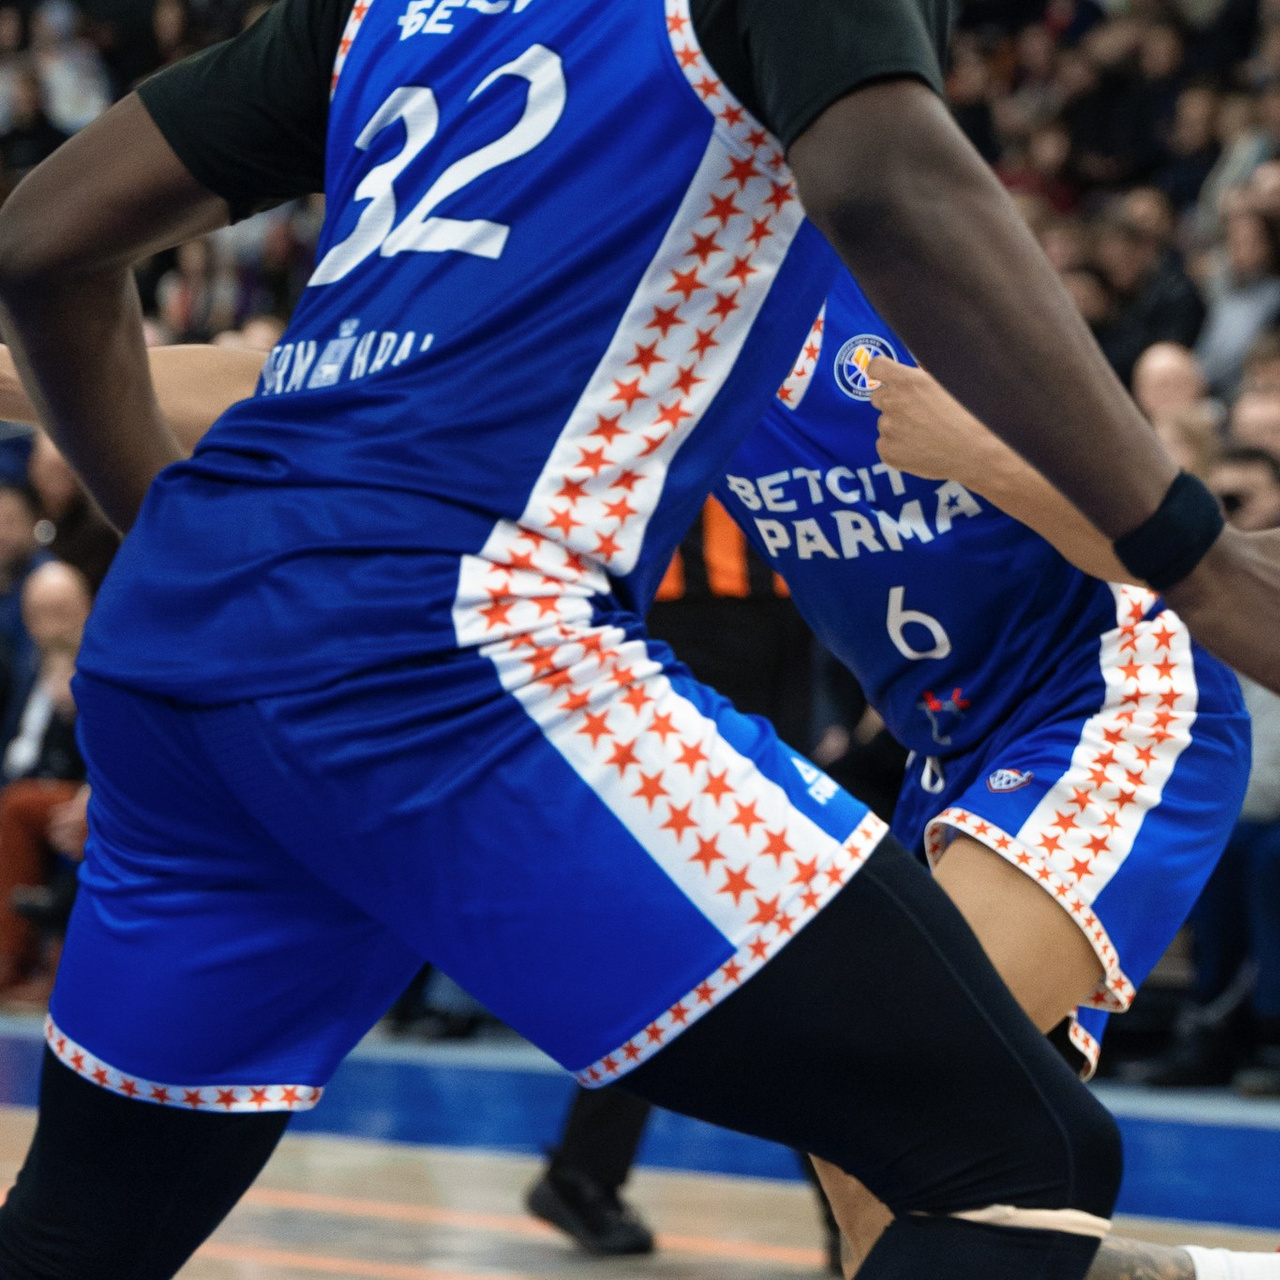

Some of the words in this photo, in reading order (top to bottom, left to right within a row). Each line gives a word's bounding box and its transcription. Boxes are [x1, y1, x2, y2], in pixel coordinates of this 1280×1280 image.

[306, 43, 566, 287] 32
[726, 462, 906, 512] BETCIT
[753, 479, 983, 559] PARMA
[886, 585, 952, 660] 6
